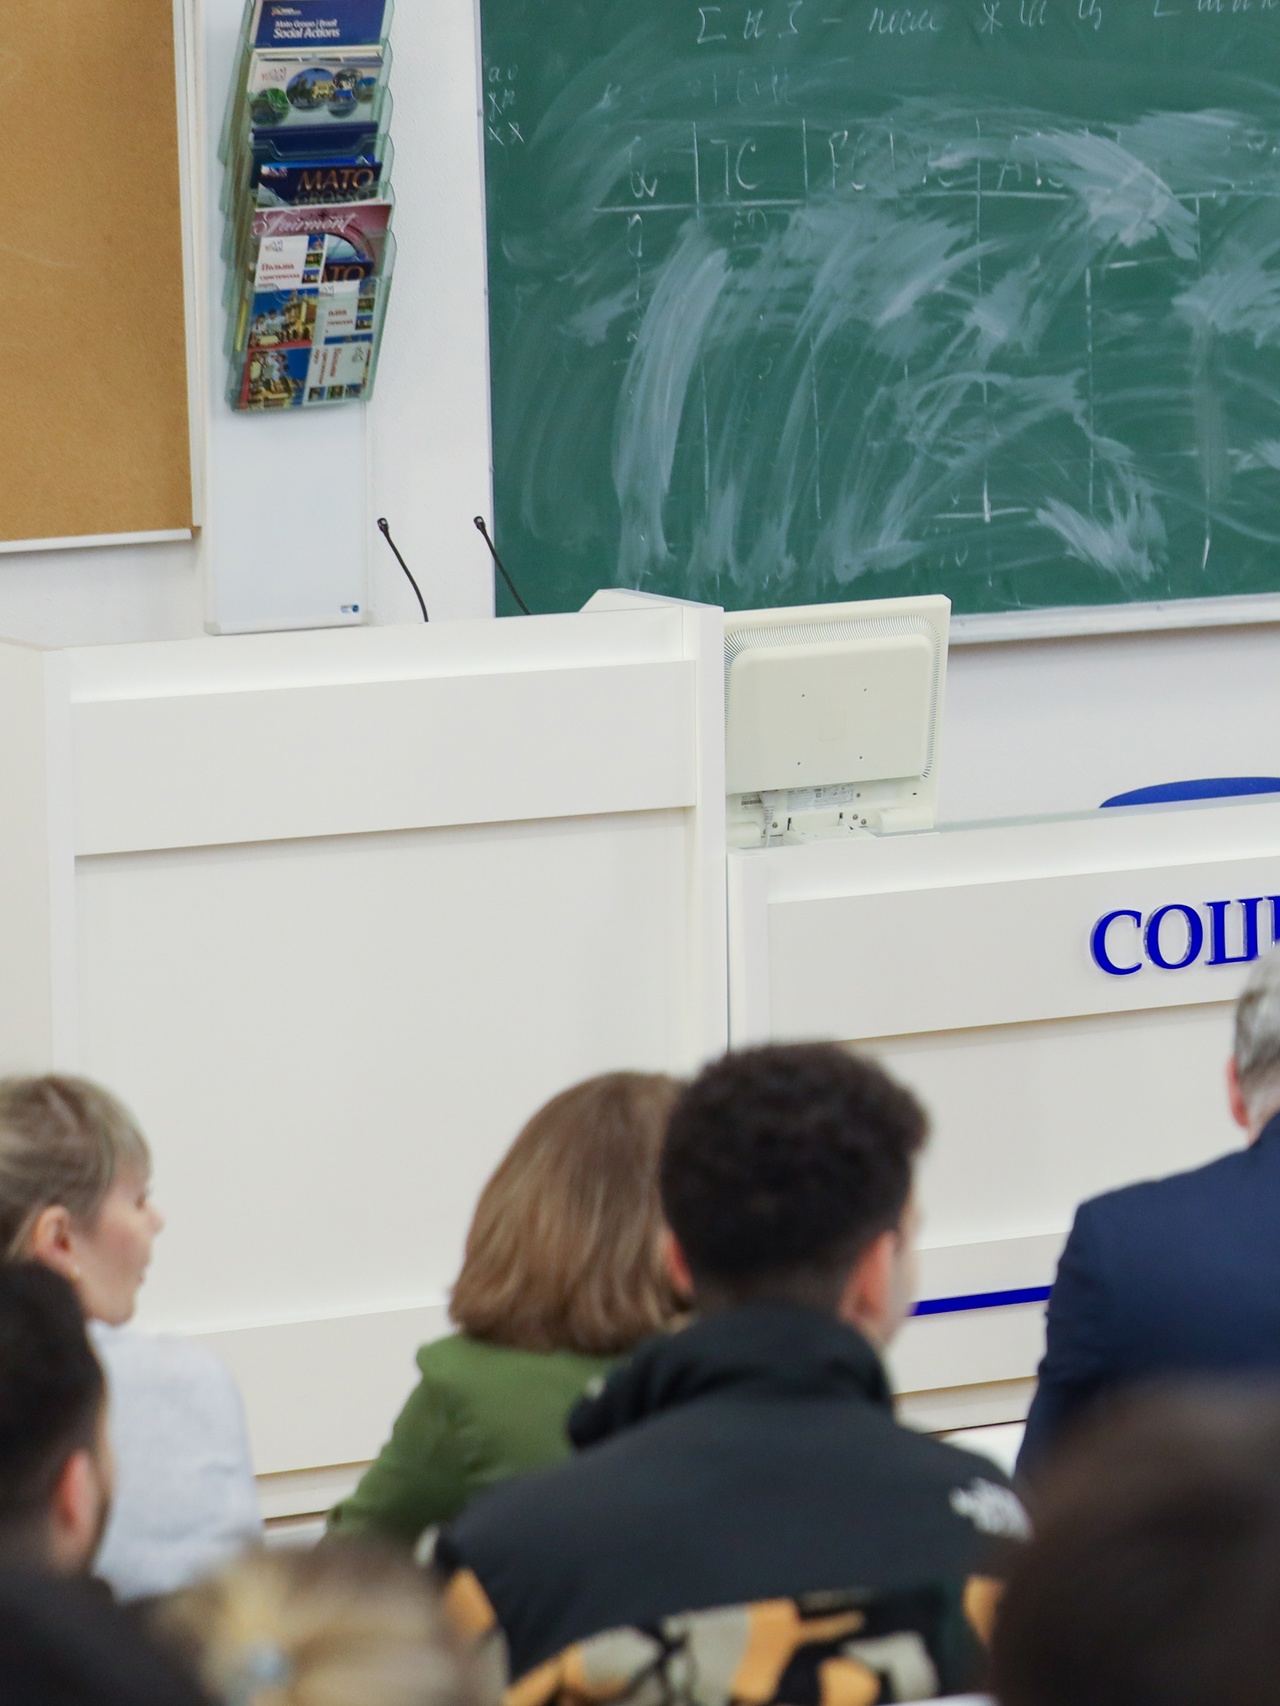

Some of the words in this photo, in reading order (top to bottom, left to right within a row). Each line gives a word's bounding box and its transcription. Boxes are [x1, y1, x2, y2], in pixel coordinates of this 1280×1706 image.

[273, 28, 304, 39] Social
[304, 28, 341, 38] Actions
[298, 168, 374, 191] MATO
